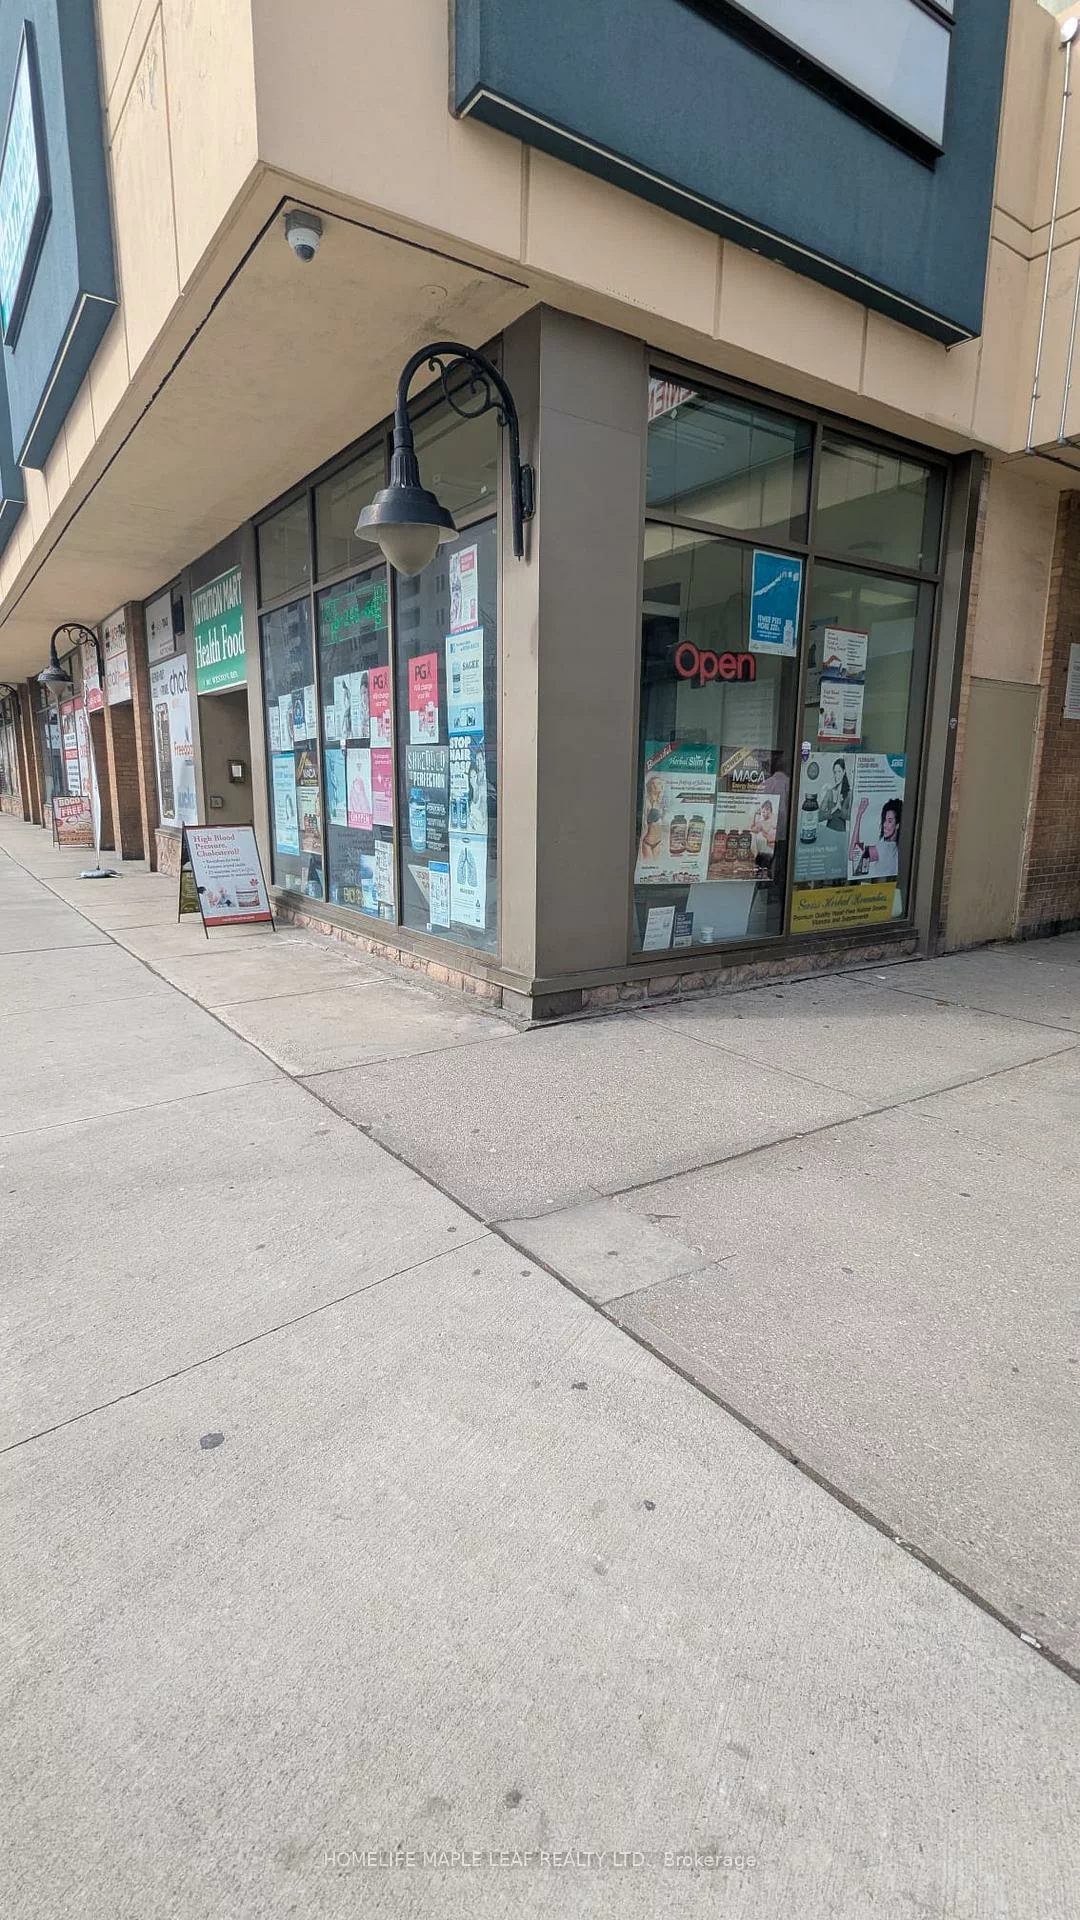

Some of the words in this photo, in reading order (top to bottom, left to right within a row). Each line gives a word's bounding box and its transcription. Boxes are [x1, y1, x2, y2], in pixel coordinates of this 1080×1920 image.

[192, 582, 222, 625] NUTRITION
[222, 571, 242, 613] MART
[194, 626, 221, 669] Health
[220, 616, 246, 660] Food
[675, 642, 755, 687] Open
[449, 736, 471, 749] STOP
[449, 749, 471, 761] HAIR
[413, 772, 445, 788] PERFECTION
[732, 769, 766, 783] MACA
[194, 835, 213, 844] High
[214, 833, 236, 841] Blood
